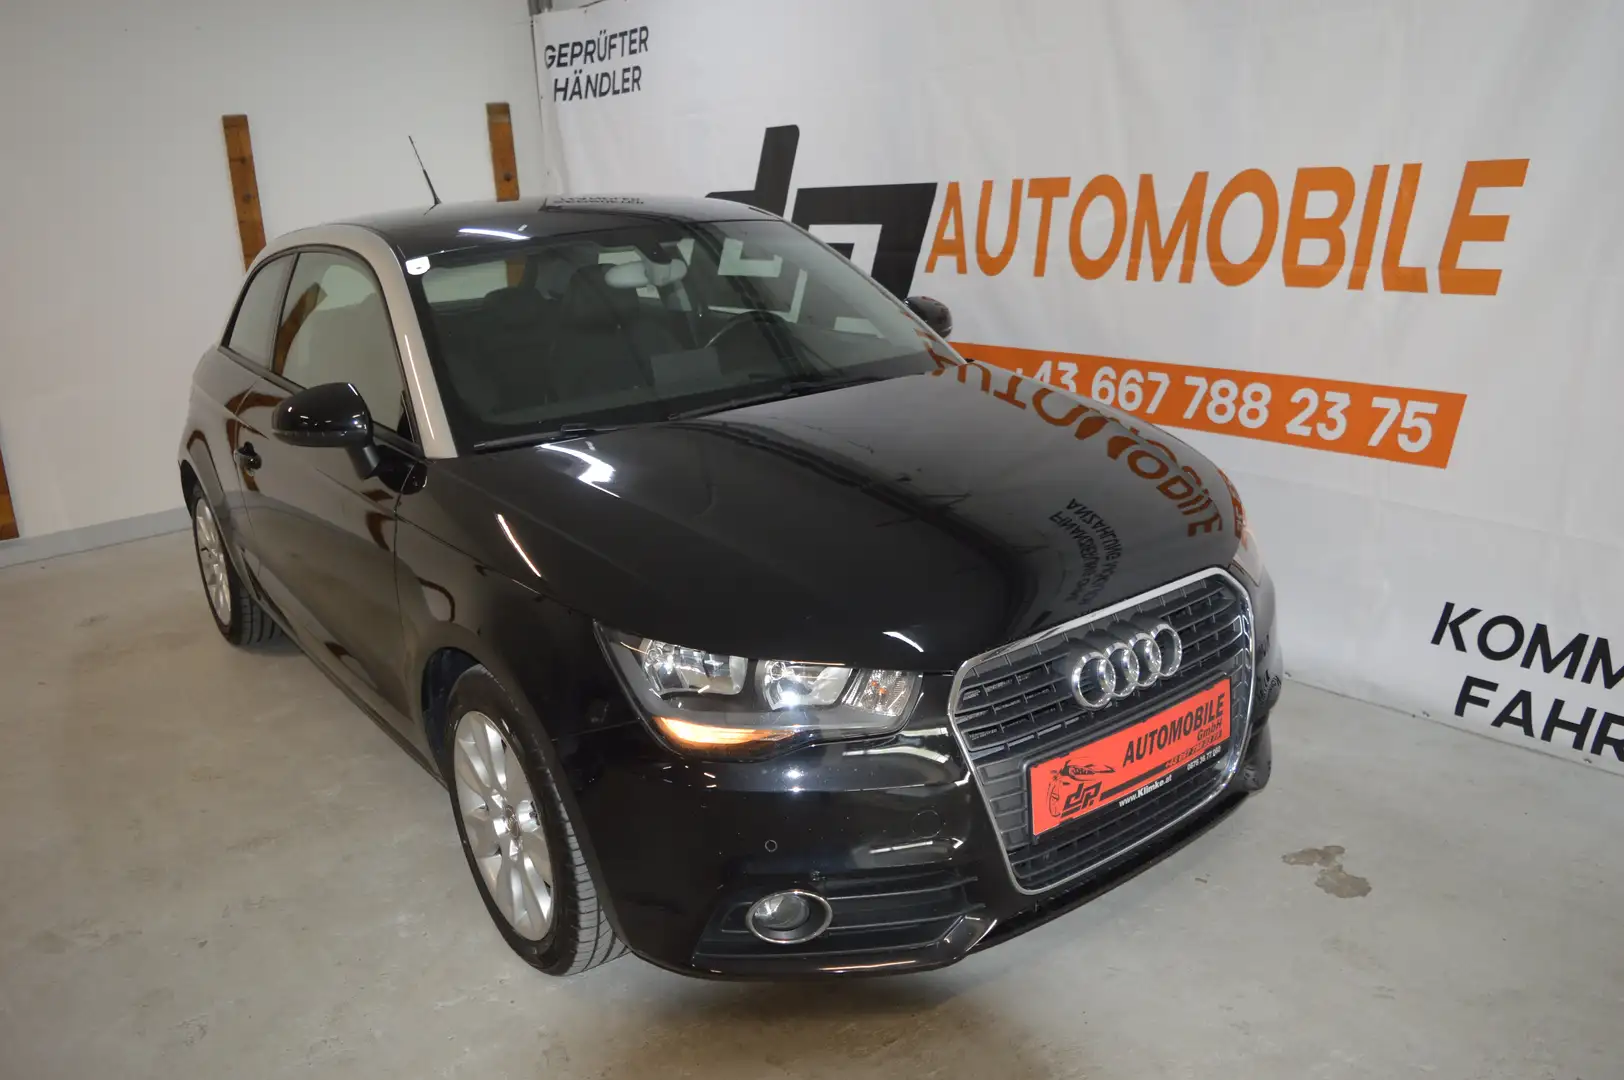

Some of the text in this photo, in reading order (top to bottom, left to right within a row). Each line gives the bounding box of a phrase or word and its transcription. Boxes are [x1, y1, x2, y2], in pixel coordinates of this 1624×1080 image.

[544, 26, 649, 70] GEPRÜFTER
[553, 66, 642, 102] HÄNDLER
[925, 159, 1530, 296] AUTOMOBILE
[1016, 360, 1439, 453] 43 667 788 23 75
[1123, 693, 1225, 768] AUTOMOBILE
[1197, 718, 1223, 742] GmbH
[1118, 774, 1173, 808] www.Klimke.at
